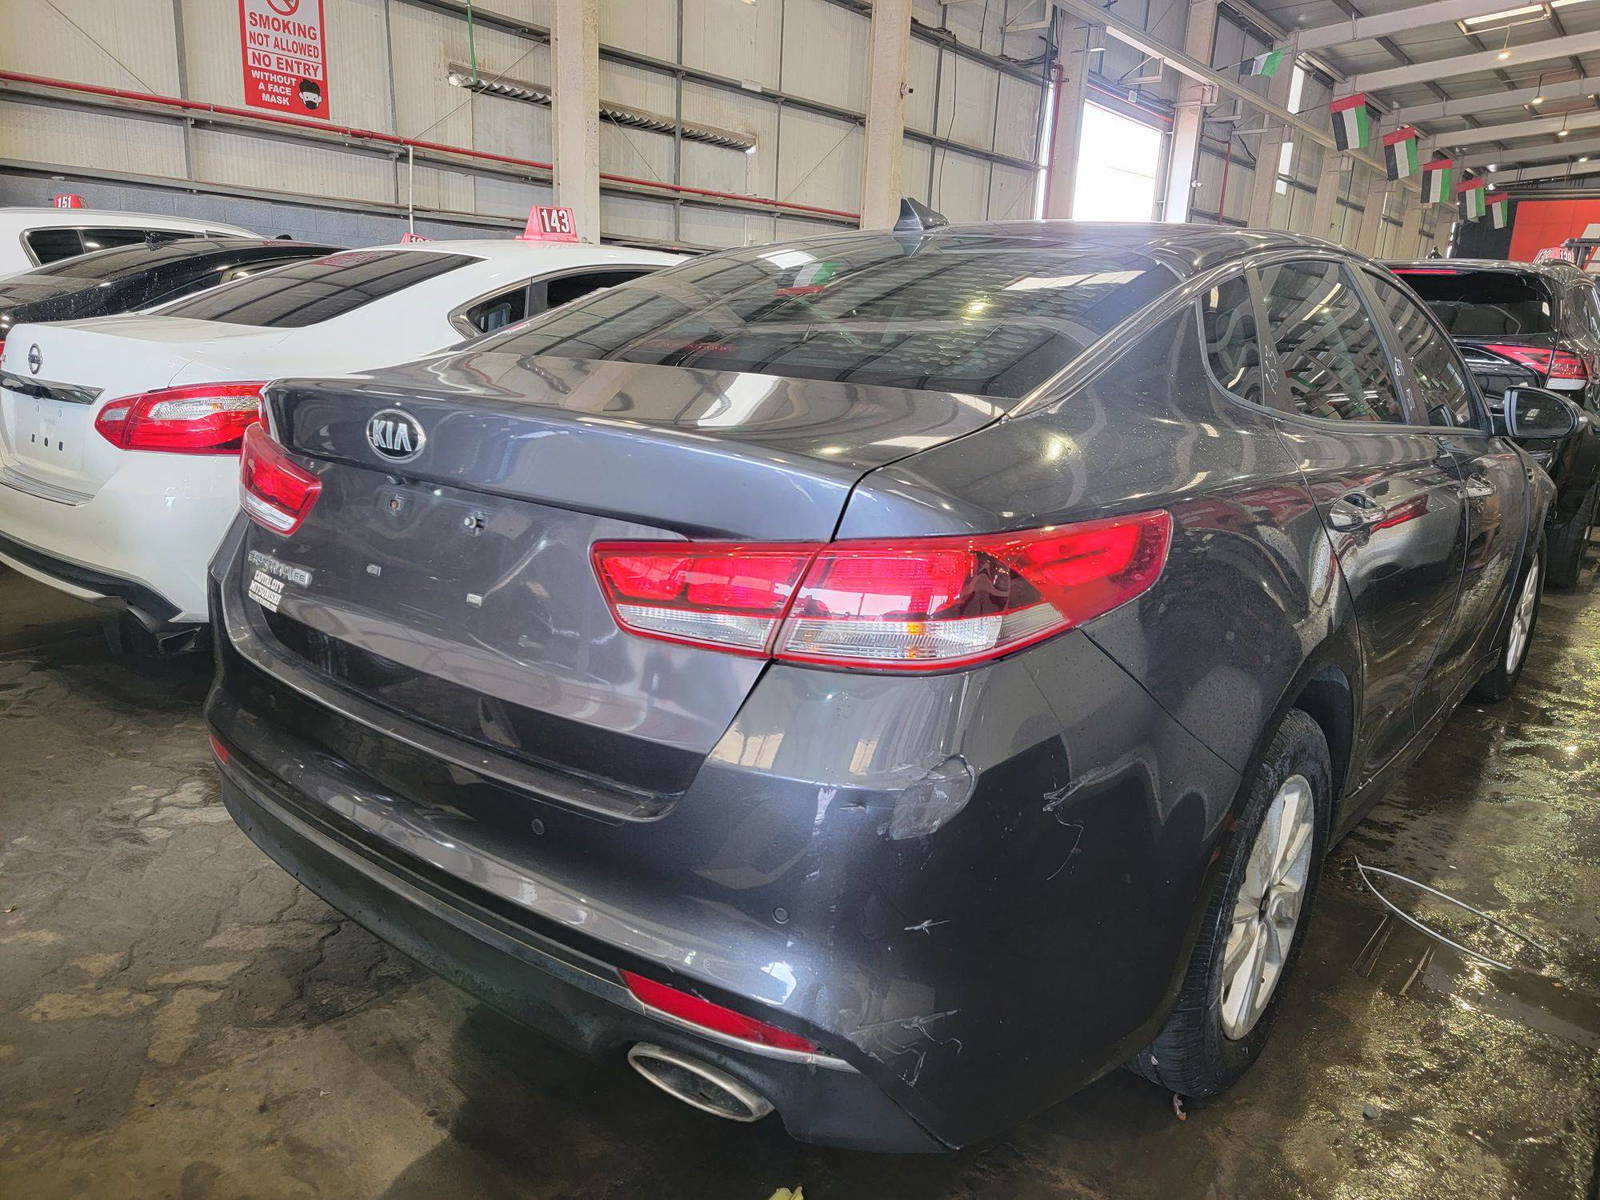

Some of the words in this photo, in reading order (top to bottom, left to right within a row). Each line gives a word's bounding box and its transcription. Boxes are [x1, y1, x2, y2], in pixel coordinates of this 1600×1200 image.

[249, 12, 317, 40] SMOKING
[249, 31, 270, 47] NOT
[273, 36, 319, 59] ALLOWED
[252, 51, 271, 67] NO
[276, 57, 319, 78] ENTRY
[251, 69, 297, 86] WITHOUT
[258, 82, 265, 91] A
[268, 84, 292, 96] FACE
[261, 93, 290, 106] MASK
[57, 196, 72, 208] 151
[541, 208, 570, 233] 143
[372, 419, 412, 452] KIA
